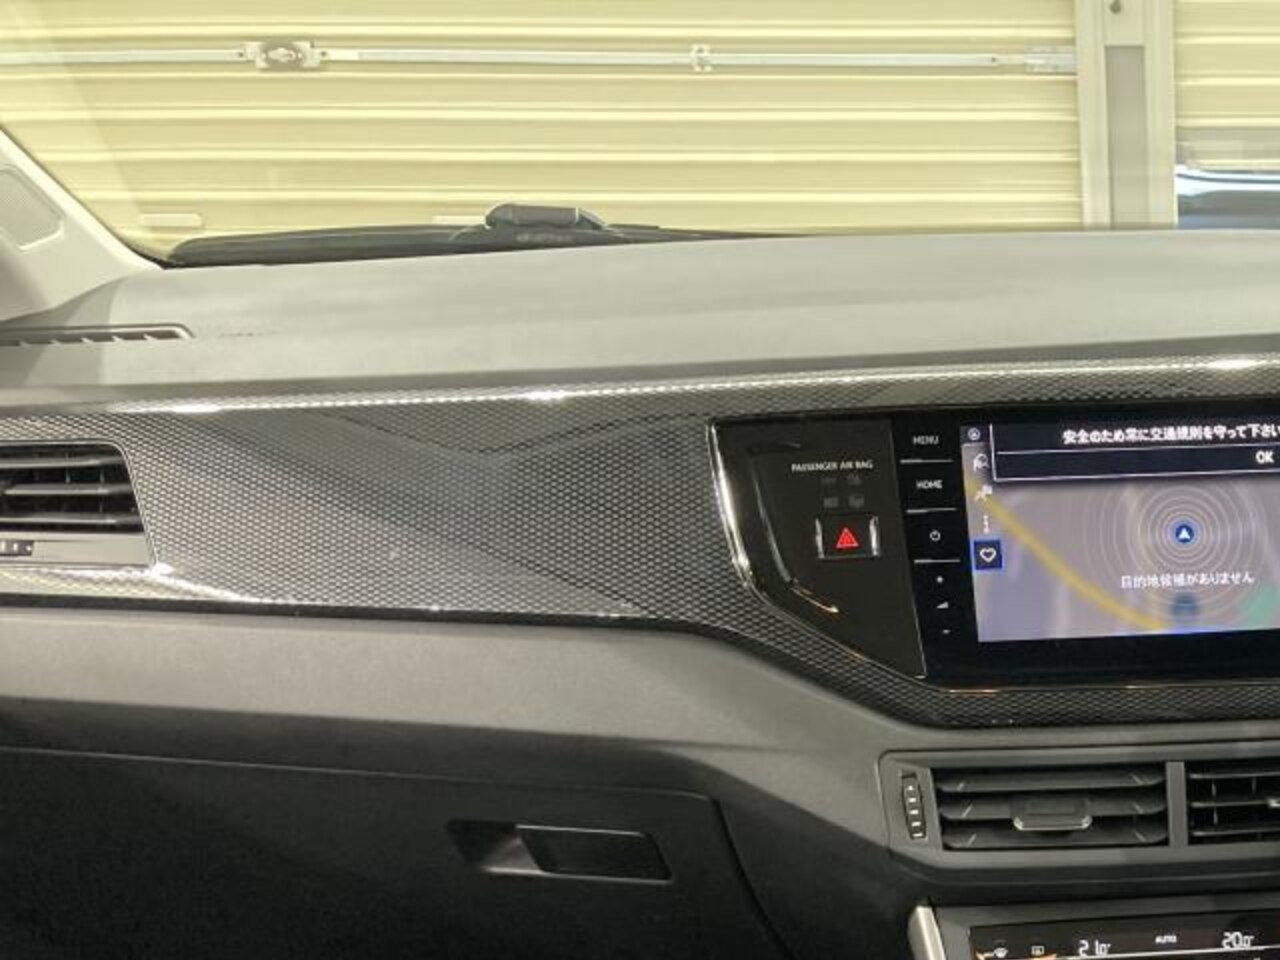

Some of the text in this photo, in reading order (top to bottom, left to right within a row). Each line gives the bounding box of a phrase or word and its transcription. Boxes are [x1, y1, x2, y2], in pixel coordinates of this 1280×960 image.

[912, 435, 940, 446] MENU
[1255, 450, 1275, 464] OK
[791, 459, 874, 474] PASSENGER AIR BAG
[916, 479, 943, 490] HOME
[1154, 934, 1178, 945] AUTO
